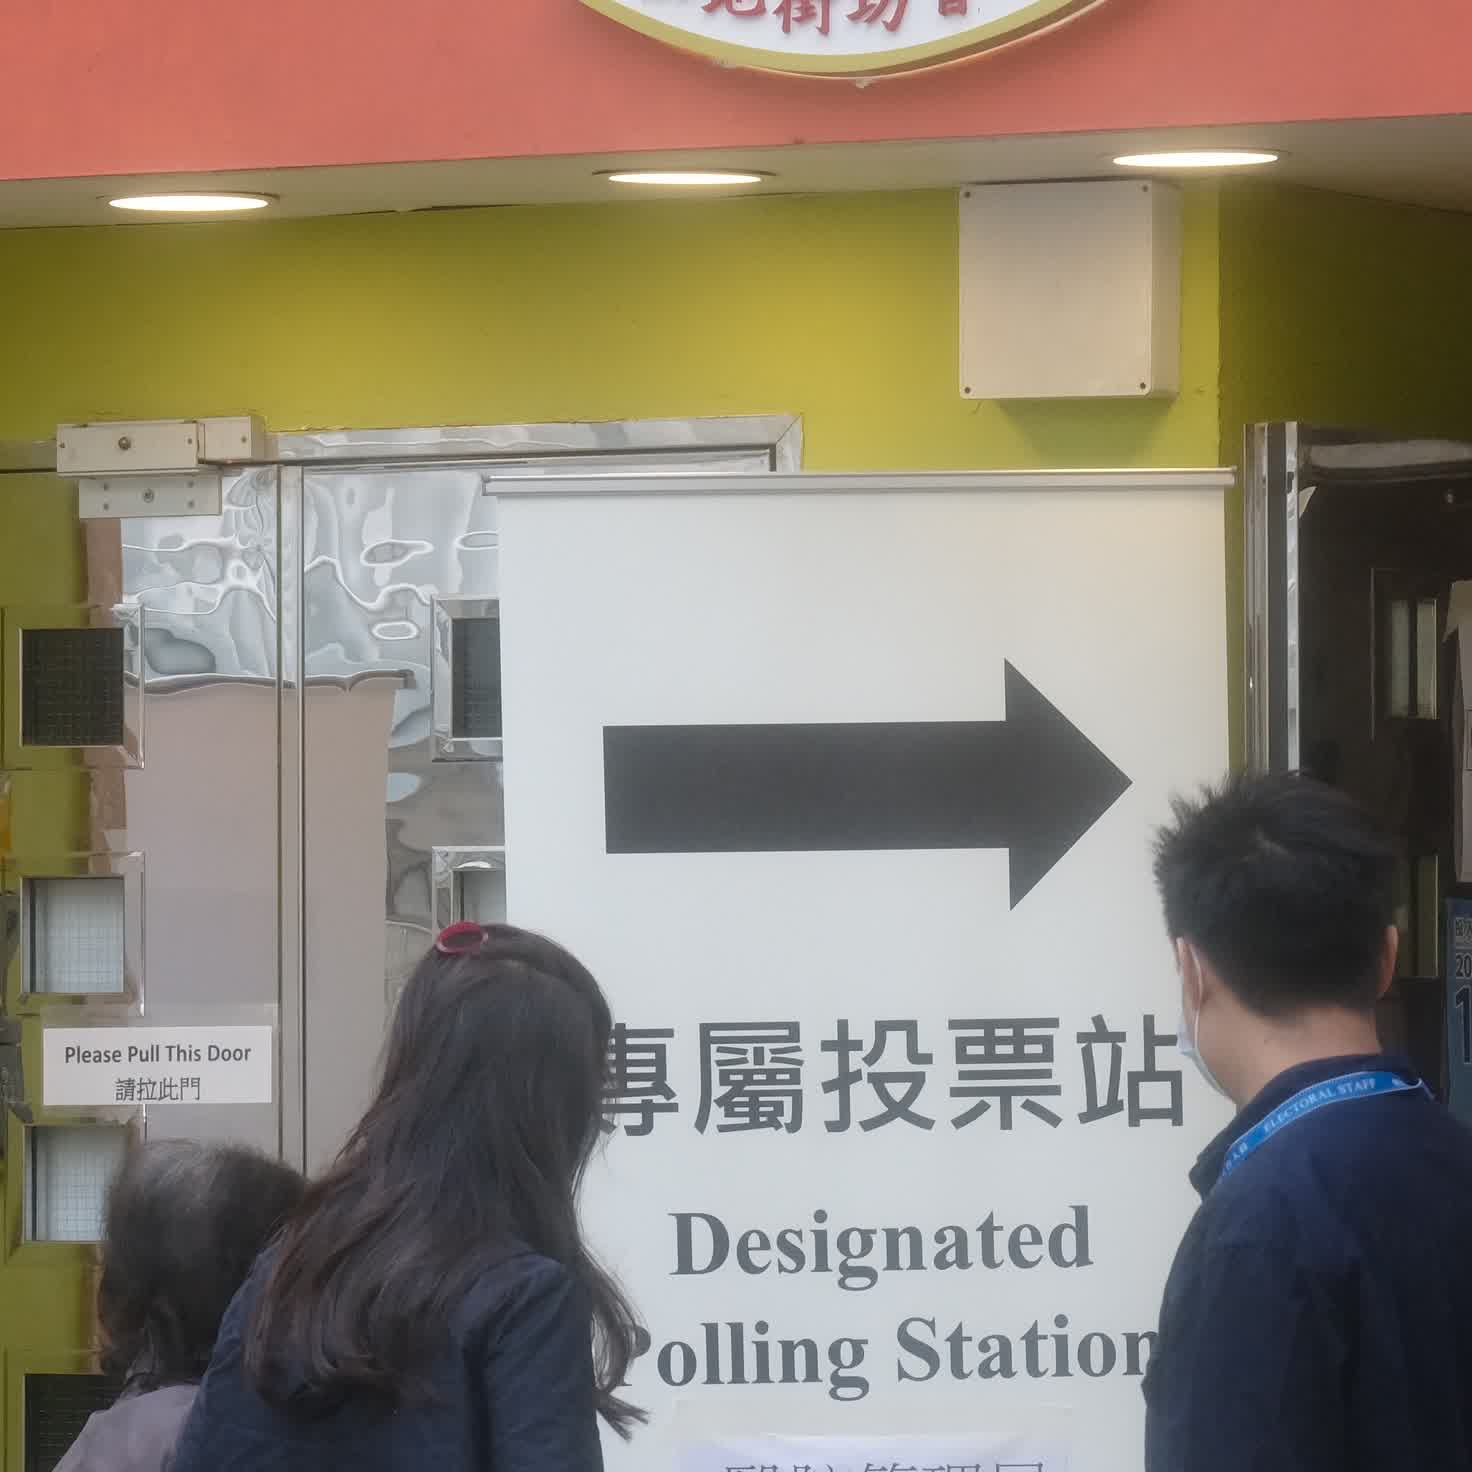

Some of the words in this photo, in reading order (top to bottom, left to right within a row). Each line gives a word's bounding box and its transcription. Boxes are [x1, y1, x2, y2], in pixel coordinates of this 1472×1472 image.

[64, 1045, 122, 1064] Please
[127, 1044, 160, 1062] Pull
[165, 1043, 202, 1062] This
[207, 1043, 252, 1062] Door
[601, 1014, 1184, 1137] 專屬投票站
[114, 1077, 201, 1102] 請拉此門
[668, 1204, 1094, 1292] Designated
